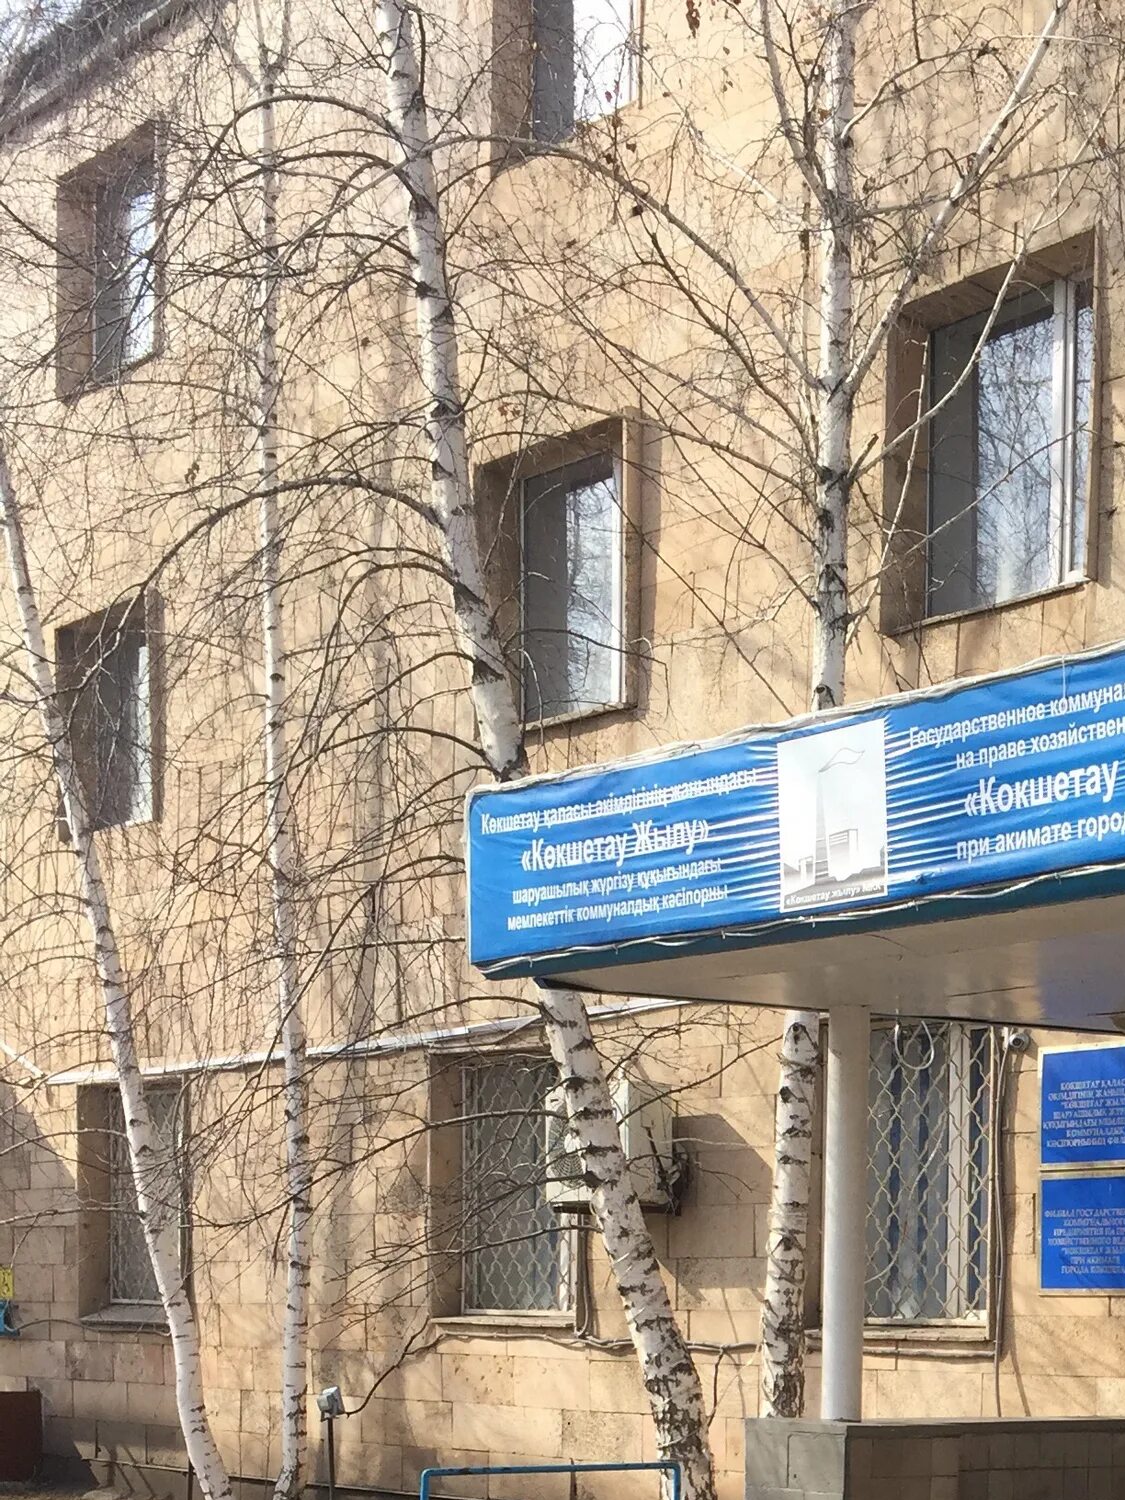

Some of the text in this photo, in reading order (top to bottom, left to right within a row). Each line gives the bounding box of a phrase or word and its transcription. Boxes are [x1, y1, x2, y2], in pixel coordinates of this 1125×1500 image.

[909, 703, 1045, 749] Государственное
[956, 752, 976, 770] на
[979, 740, 1031, 768] праве
[964, 760, 1119, 817] «Кокшетау
[521, 819, 710, 871] «Көкшетау Жылу»
[956, 838, 990, 863] при
[995, 821, 1072, 852] акимате
[507, 905, 576, 931] мемлекеттік
[576, 894, 660, 922] коммуналдық
